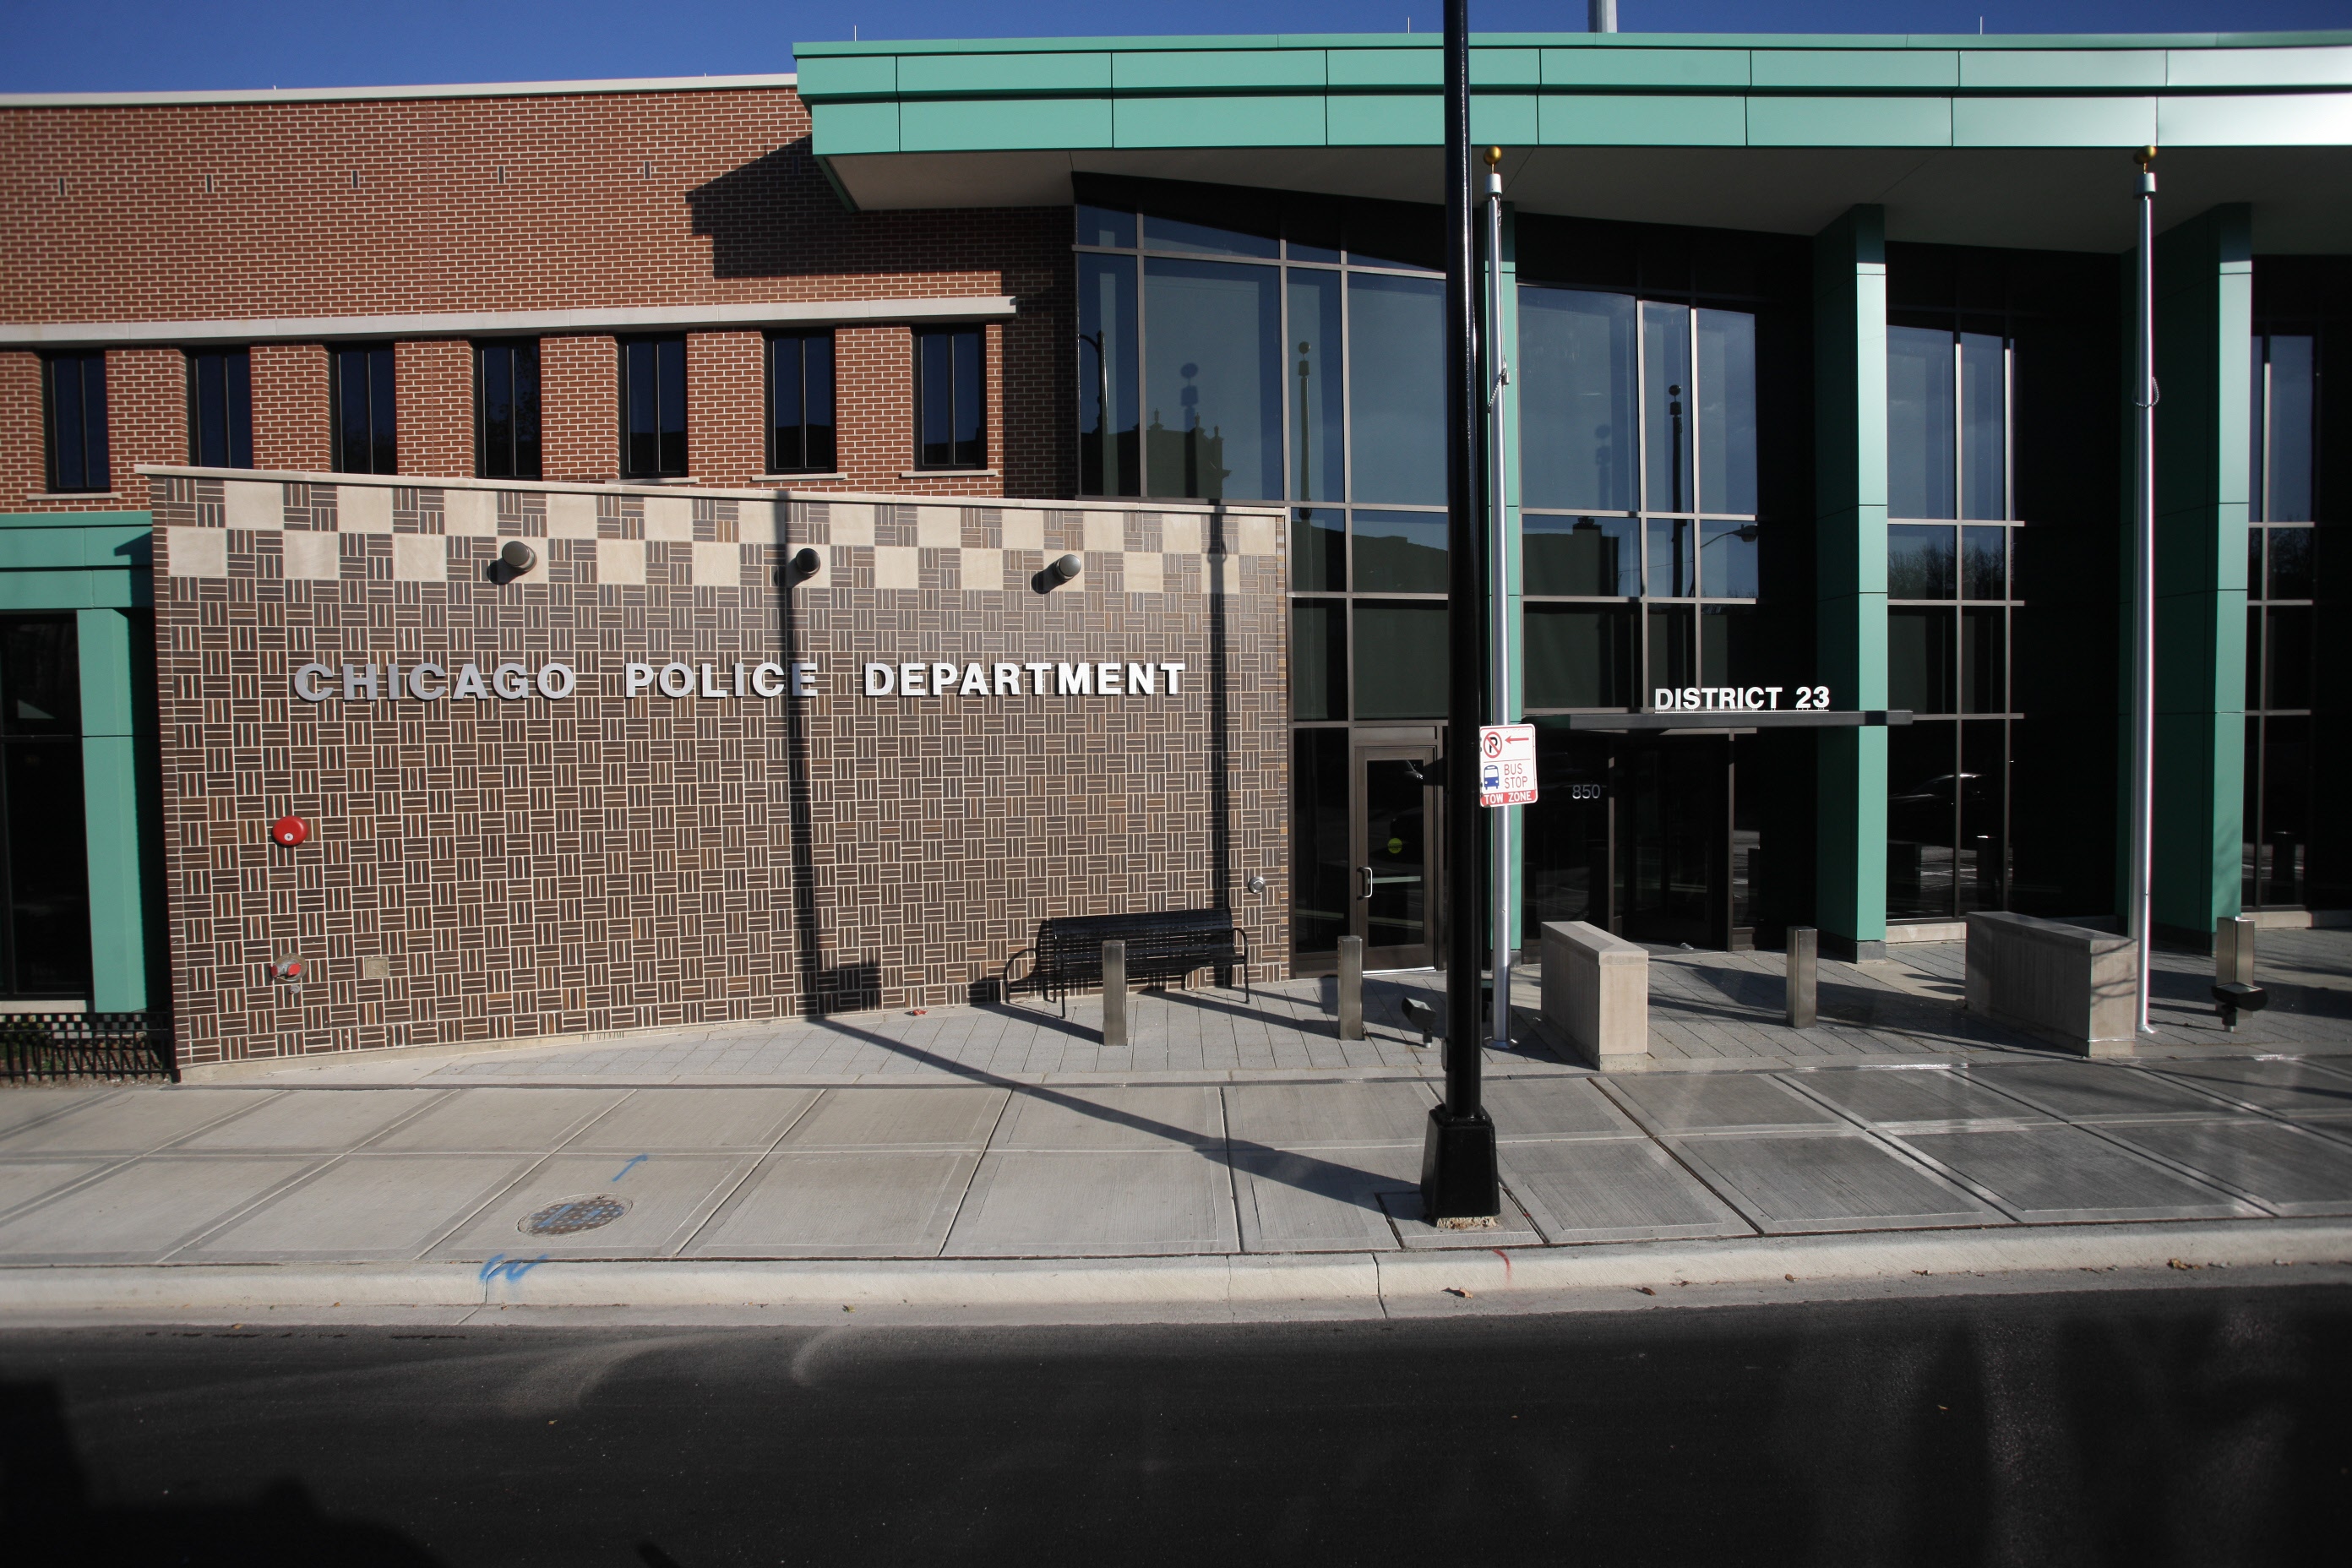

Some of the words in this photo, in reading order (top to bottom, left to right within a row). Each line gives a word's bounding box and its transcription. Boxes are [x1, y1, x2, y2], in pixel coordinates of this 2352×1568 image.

[294, 662, 576, 702] CHICAGO
[624, 662, 819, 699] POLICE
[864, 662, 1186, 697] DEPARTMENT
[1655, 687, 1783, 710] DISTRICT
[1795, 686, 1830, 709] 23
[1504, 763, 1522, 776] BUS
[1504, 776, 1528, 789] STOP
[1484, 793, 1504, 804] TOW
[1508, 791, 1532, 803] ZONE
[1572, 784, 1601, 799] 850
